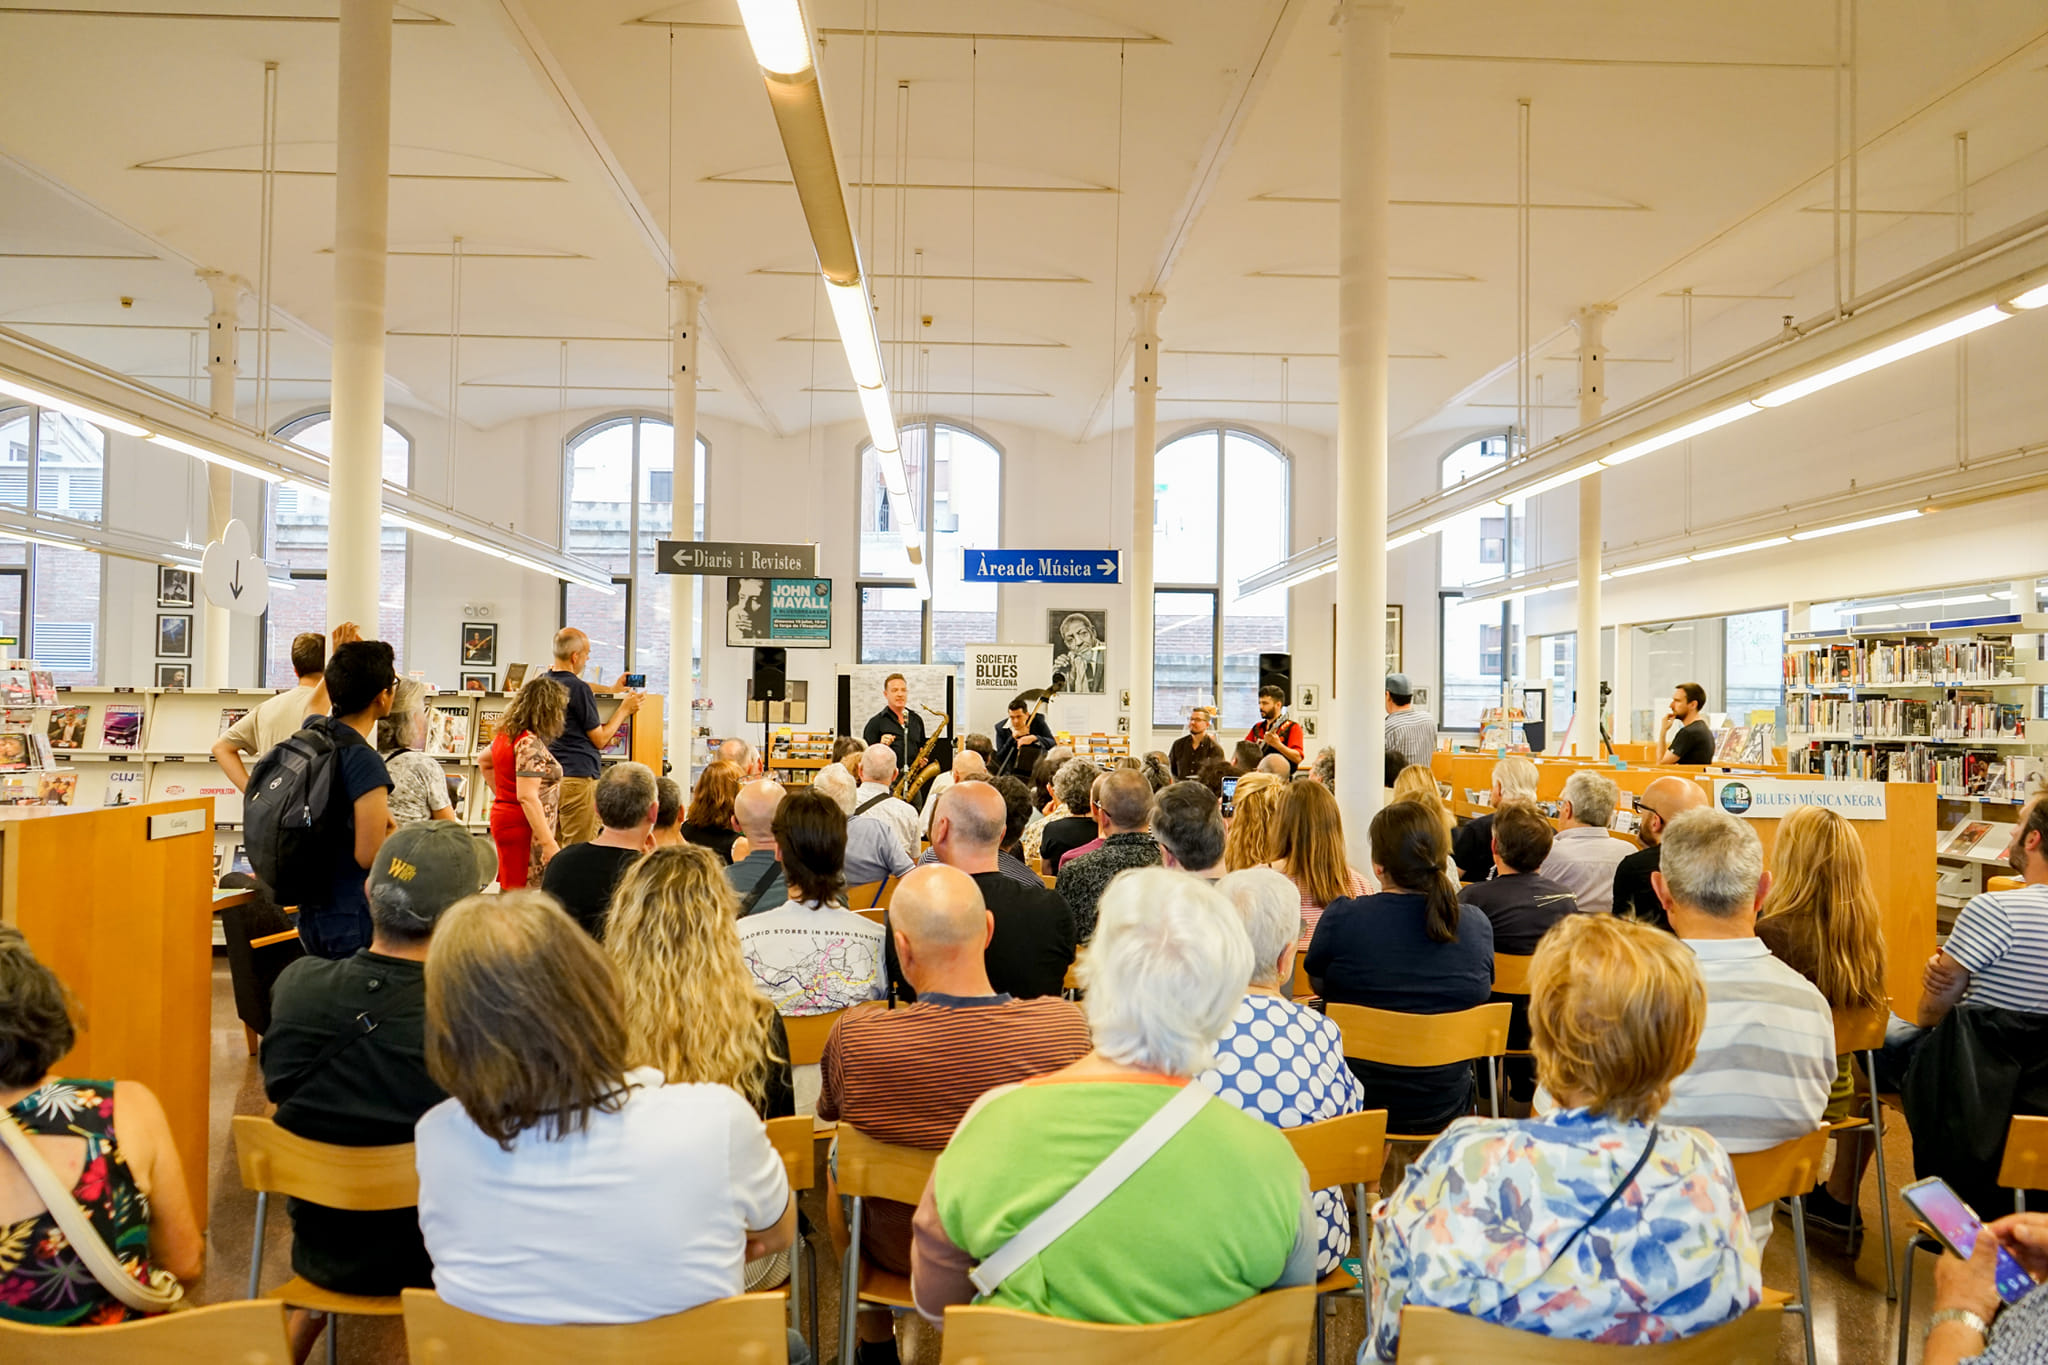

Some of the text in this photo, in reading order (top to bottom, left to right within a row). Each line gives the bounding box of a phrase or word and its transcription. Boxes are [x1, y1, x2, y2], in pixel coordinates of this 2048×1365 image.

[694, 548, 802, 570] Diaris i Revistes
[1038, 557, 1092, 577] Música
[772, 584, 811, 597] JOHN
[772, 597, 828, 609] MAYALL
[976, 654, 1018, 664] SOCIETAT
[976, 664, 1018, 678] BLUES
[110, 772, 135, 782] CLIJ
[1755, 793, 1791, 805] BLUES
[1793, 794, 1797, 805] i
[1799, 791, 1842, 806] MÚSICA
[1843, 794, 1882, 807] NEGRA
